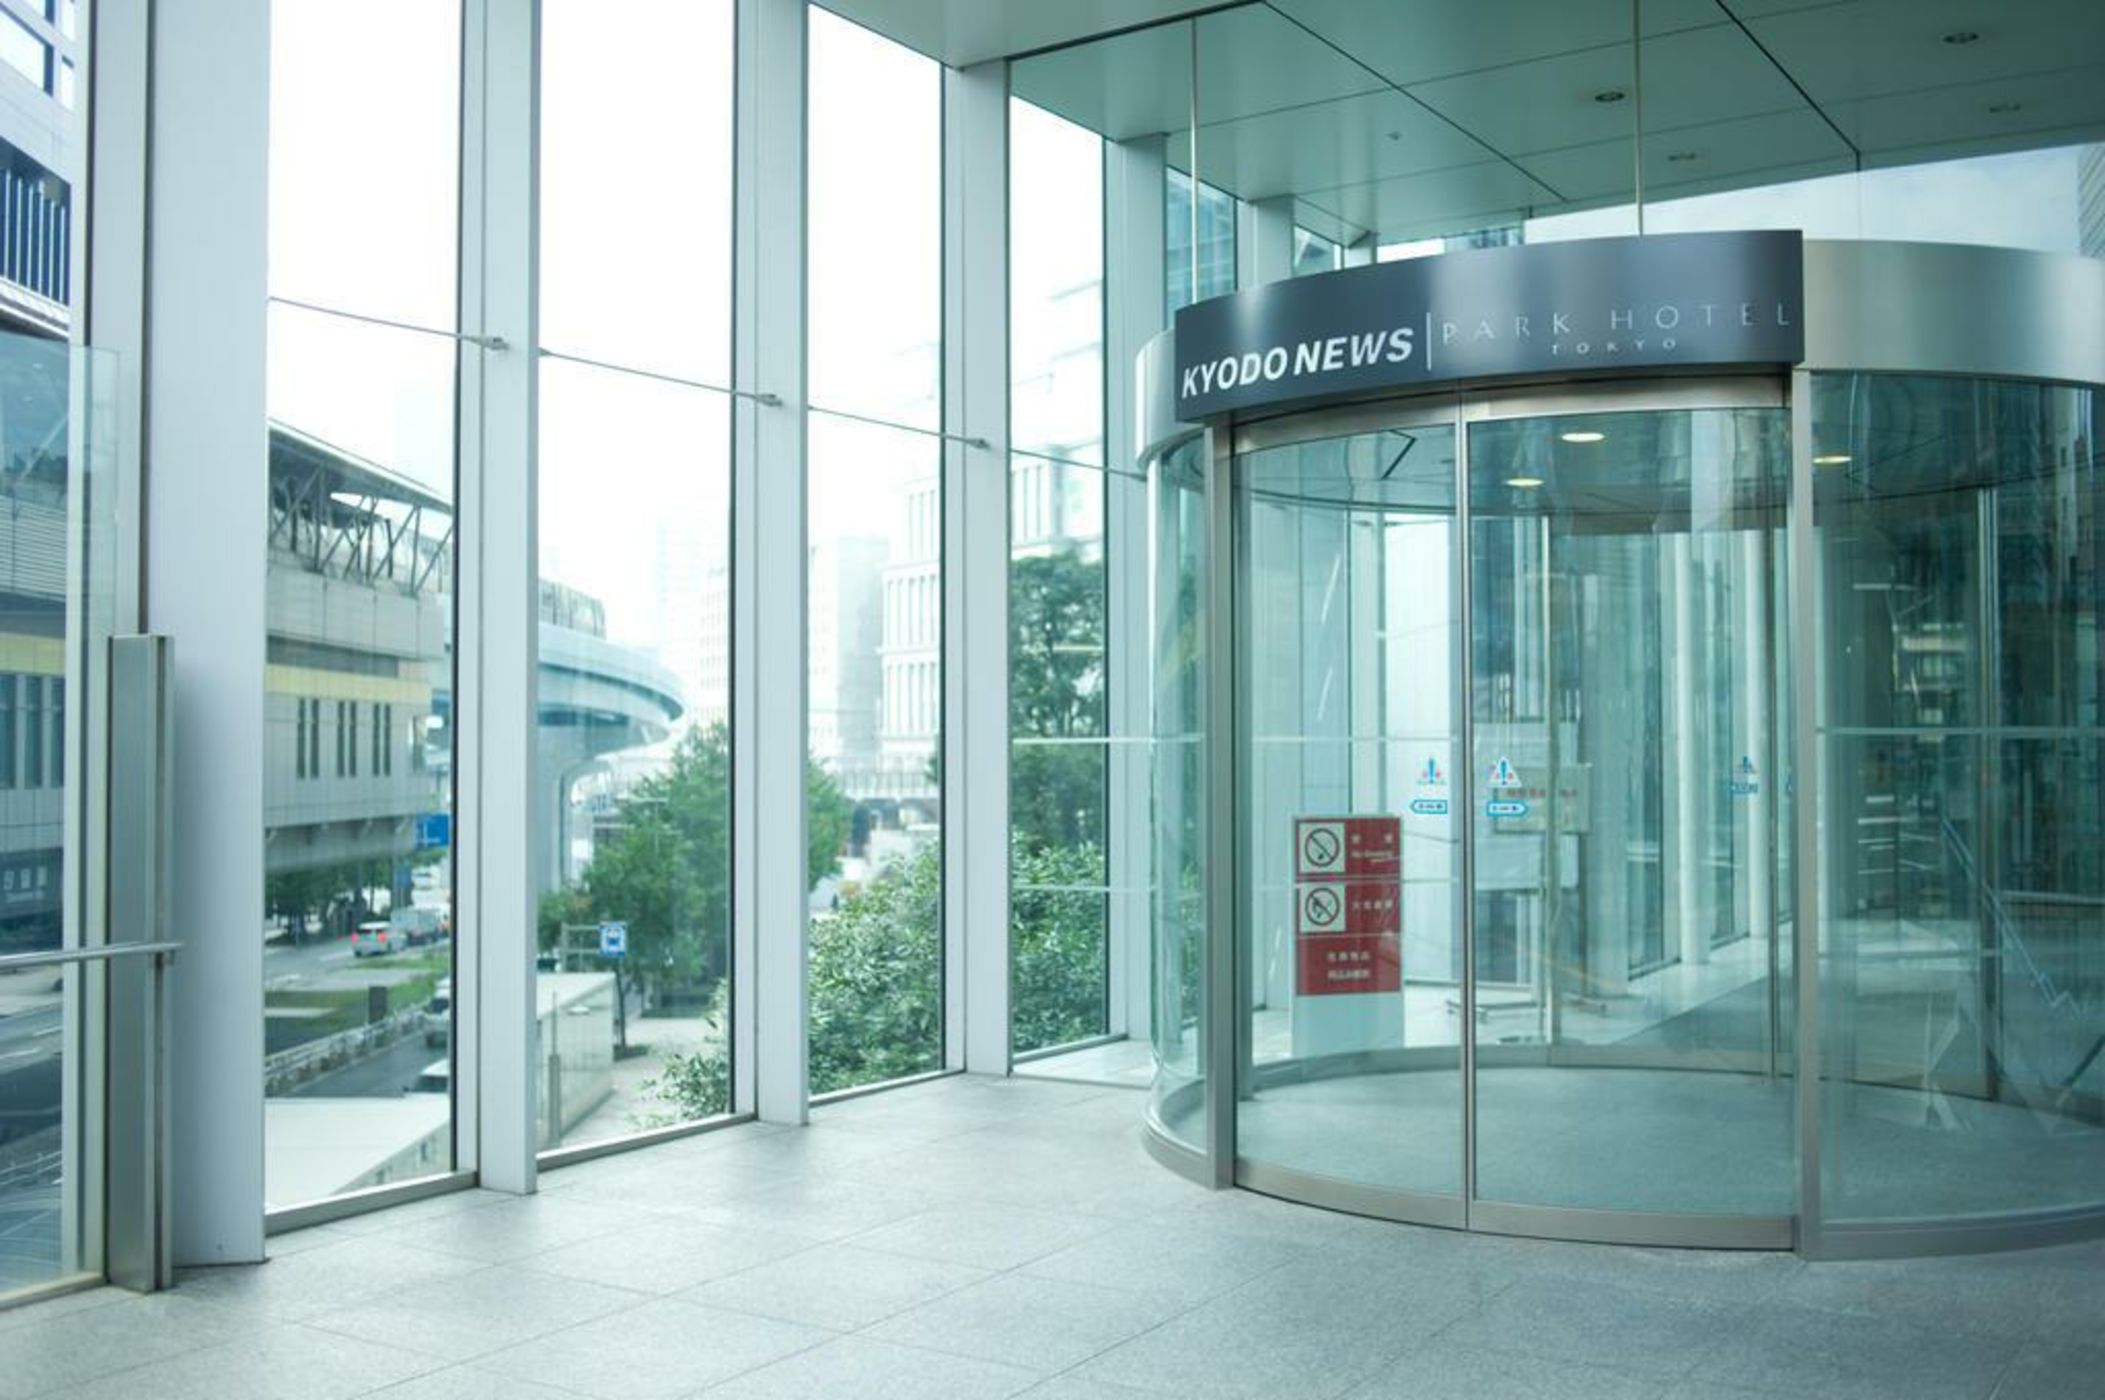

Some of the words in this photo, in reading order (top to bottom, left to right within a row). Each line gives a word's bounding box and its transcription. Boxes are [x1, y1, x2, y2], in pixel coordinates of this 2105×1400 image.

[1442, 312, 1570, 345] PARK
[1611, 302, 1790, 331] HOTEL
[1181, 346, 1288, 399] KYODO
[1294, 327, 1415, 376] NEWS
[1552, 337, 1677, 355] TOKYO
